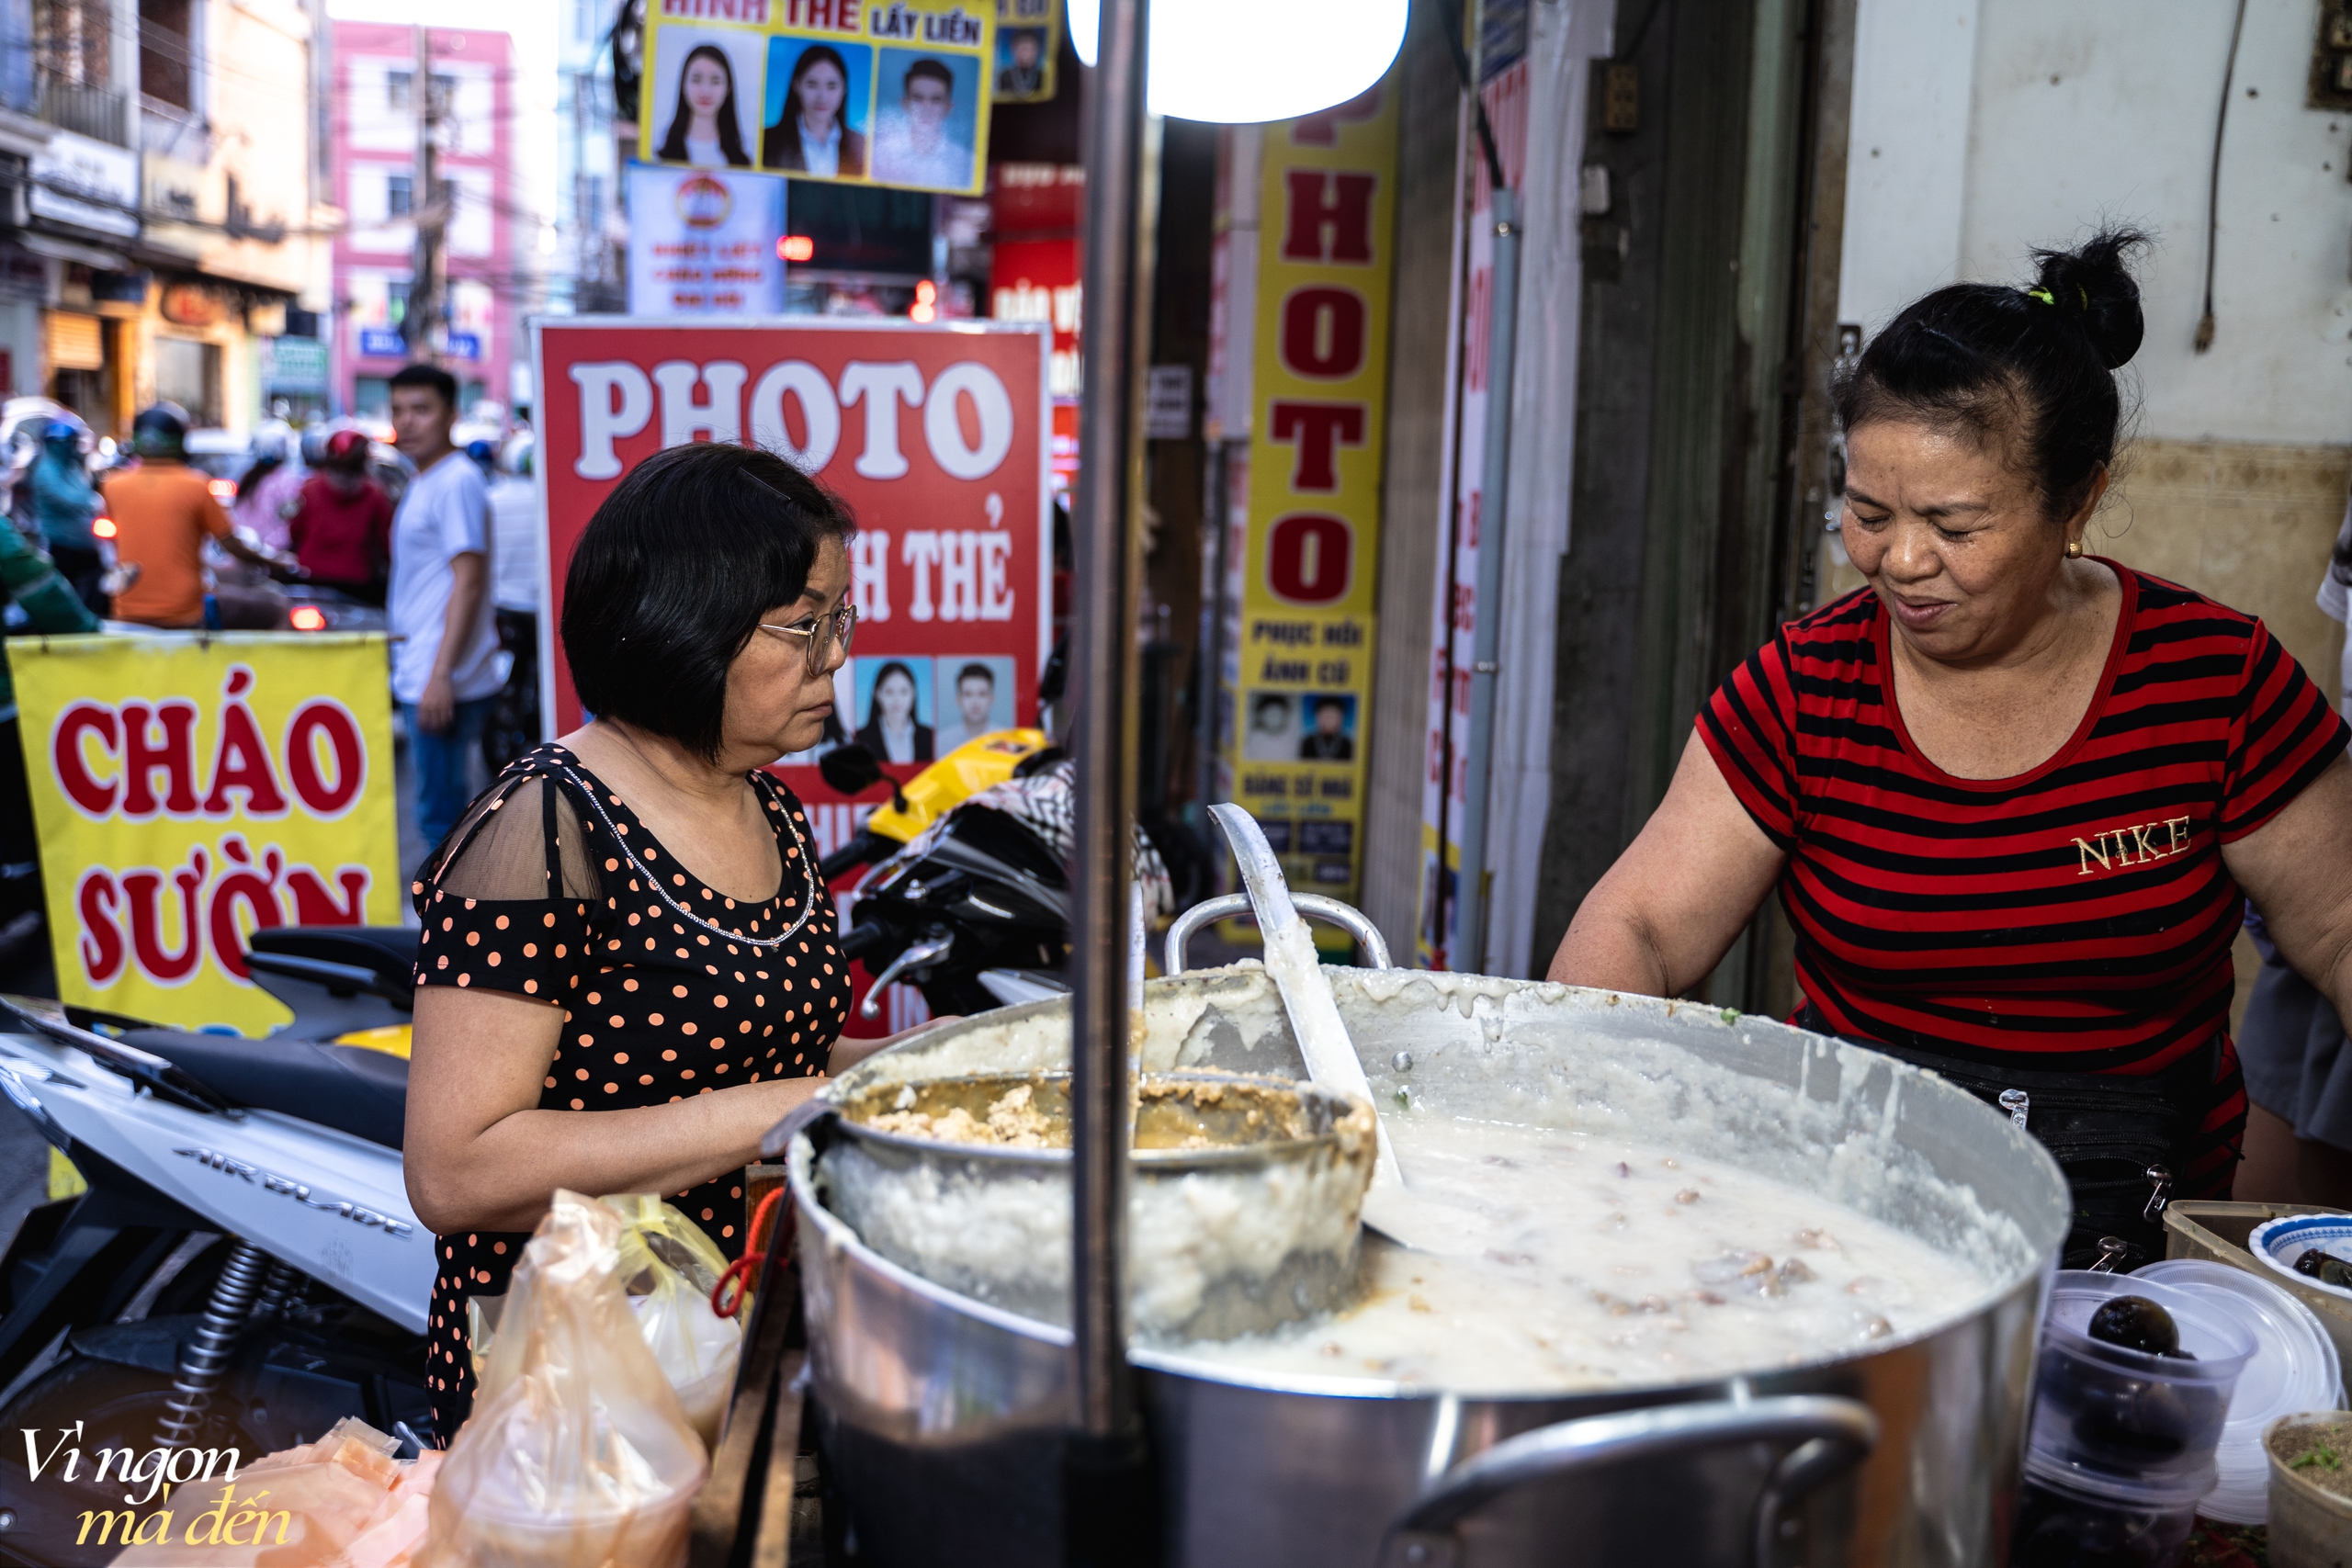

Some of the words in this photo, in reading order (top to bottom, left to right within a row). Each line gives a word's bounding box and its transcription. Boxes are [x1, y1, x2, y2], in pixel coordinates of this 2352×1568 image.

[569, 359, 1014, 480] PHOTO
[902, 492, 1015, 623] THẺ
[52, 665, 368, 819] CHÁO
[2070, 815, 2191, 875] NIKE
[76, 834, 369, 986] SƯỜN
[173, 1147, 259, 1184] AIR
[264, 1171, 413, 1239] BLADE
